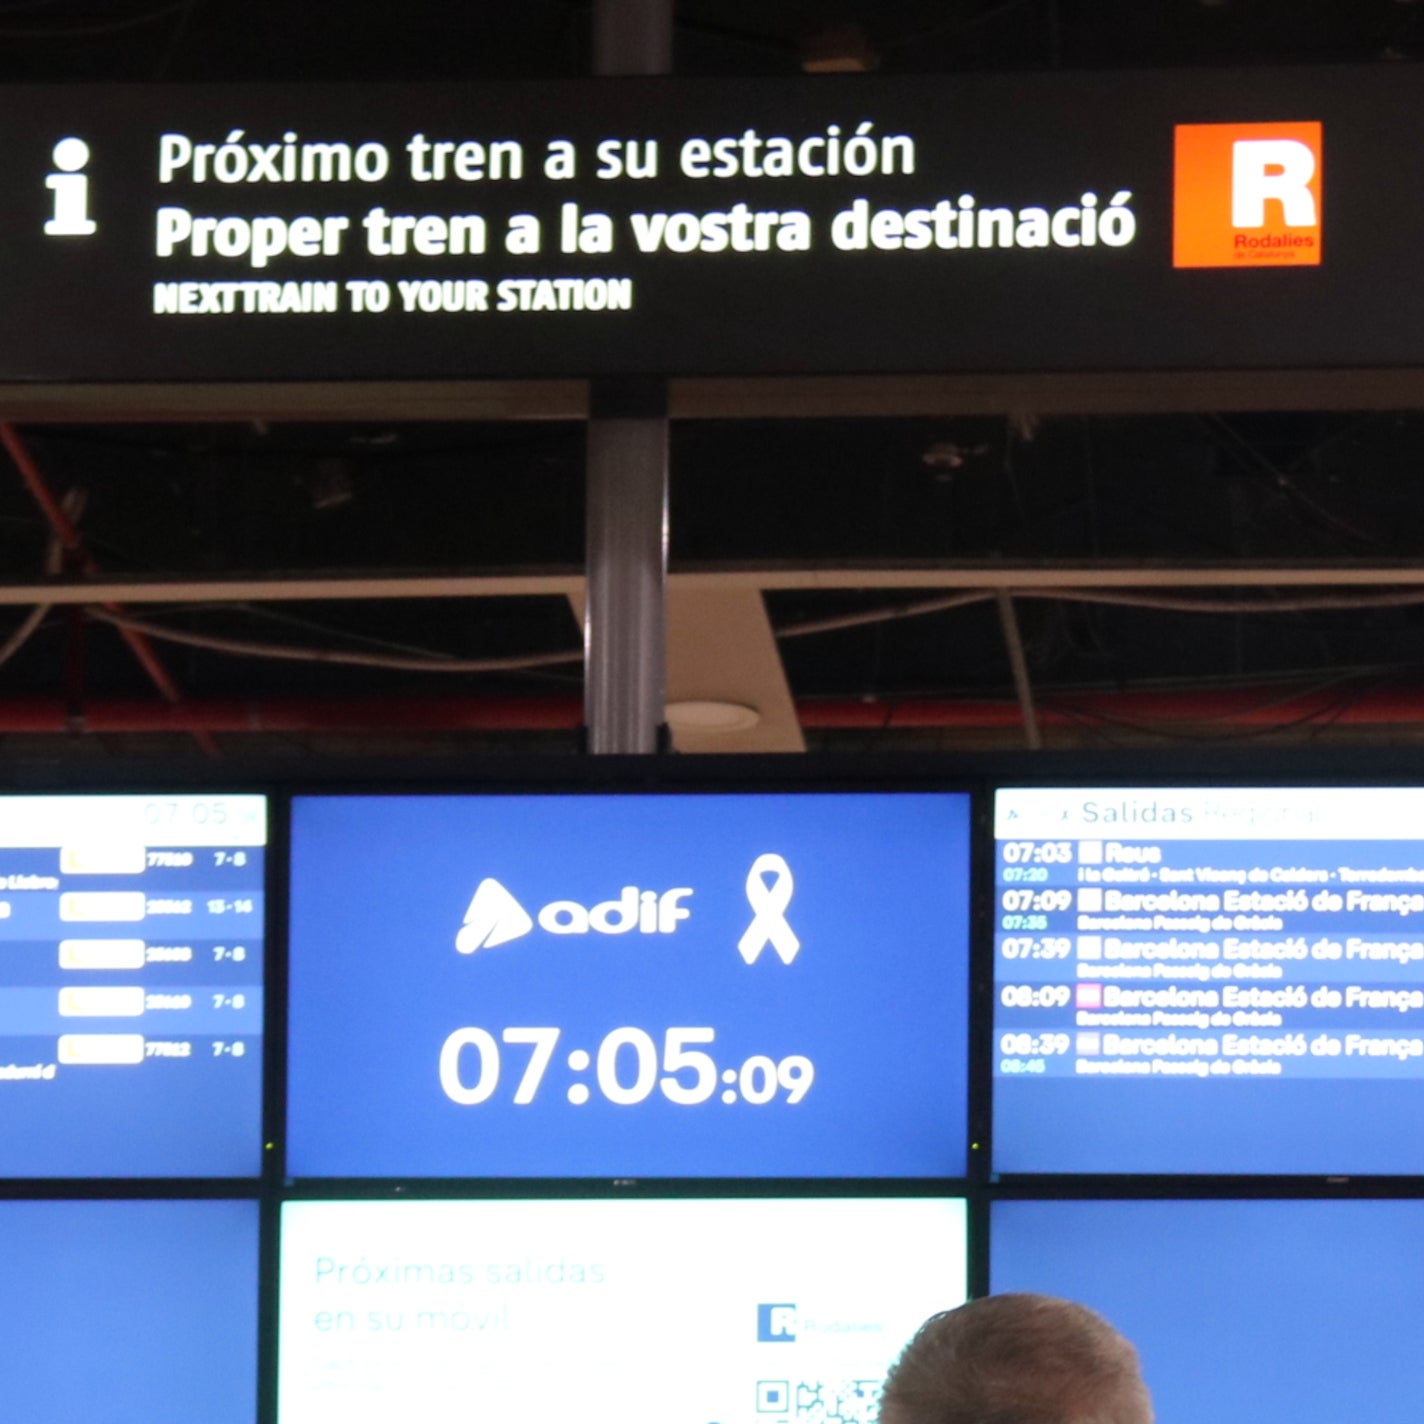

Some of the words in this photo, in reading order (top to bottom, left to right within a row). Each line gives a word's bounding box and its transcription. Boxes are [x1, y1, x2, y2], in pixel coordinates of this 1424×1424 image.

[160, 130, 388, 183] Próximo
[407, 134, 522, 181] tren
[545, 141, 575, 179] a
[597, 140, 657, 178] su
[681, 122, 914, 177] estación
[1232, 140, 1316, 228] R
[157, 208, 349, 267] Proper
[363, 208, 485, 255] tren
[506, 215, 540, 254] a
[562, 203, 613, 253] la
[630, 204, 810, 252] vostra
[832, 191, 1135, 250] destinació
[1234, 234, 1314, 248] Rodalies
[346, 281, 390, 312] TO
[398, 280, 488, 312] YOUR
[497, 279, 632, 311] STATION
[1082, 801, 1193, 824] Salidas
[538, 887, 693, 934] adif
[314, 1255, 474, 1286] Próximas
[485, 1255, 605, 1286] salidas
[313, 1306, 355, 1332] en
[366, 1306, 403, 1332] su
